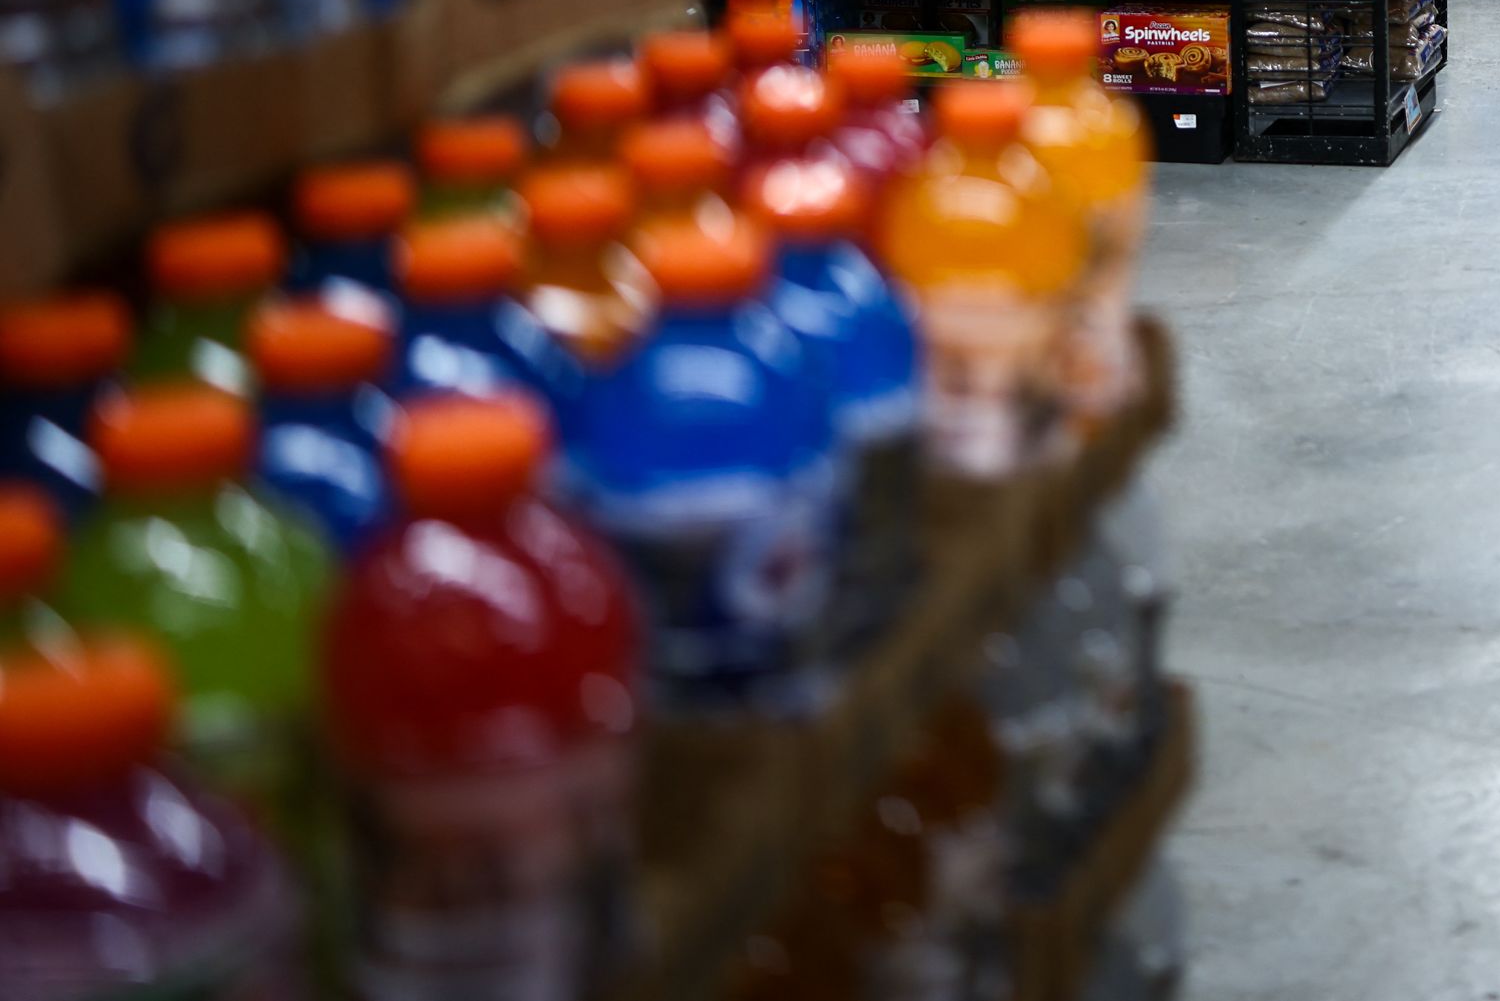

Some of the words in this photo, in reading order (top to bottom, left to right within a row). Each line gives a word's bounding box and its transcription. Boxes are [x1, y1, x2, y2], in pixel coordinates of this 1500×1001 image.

[1125, 26, 1210, 44] Spinwheels
[854, 44, 896, 57] BANANA
[1103, 74, 1112, 83] 8
